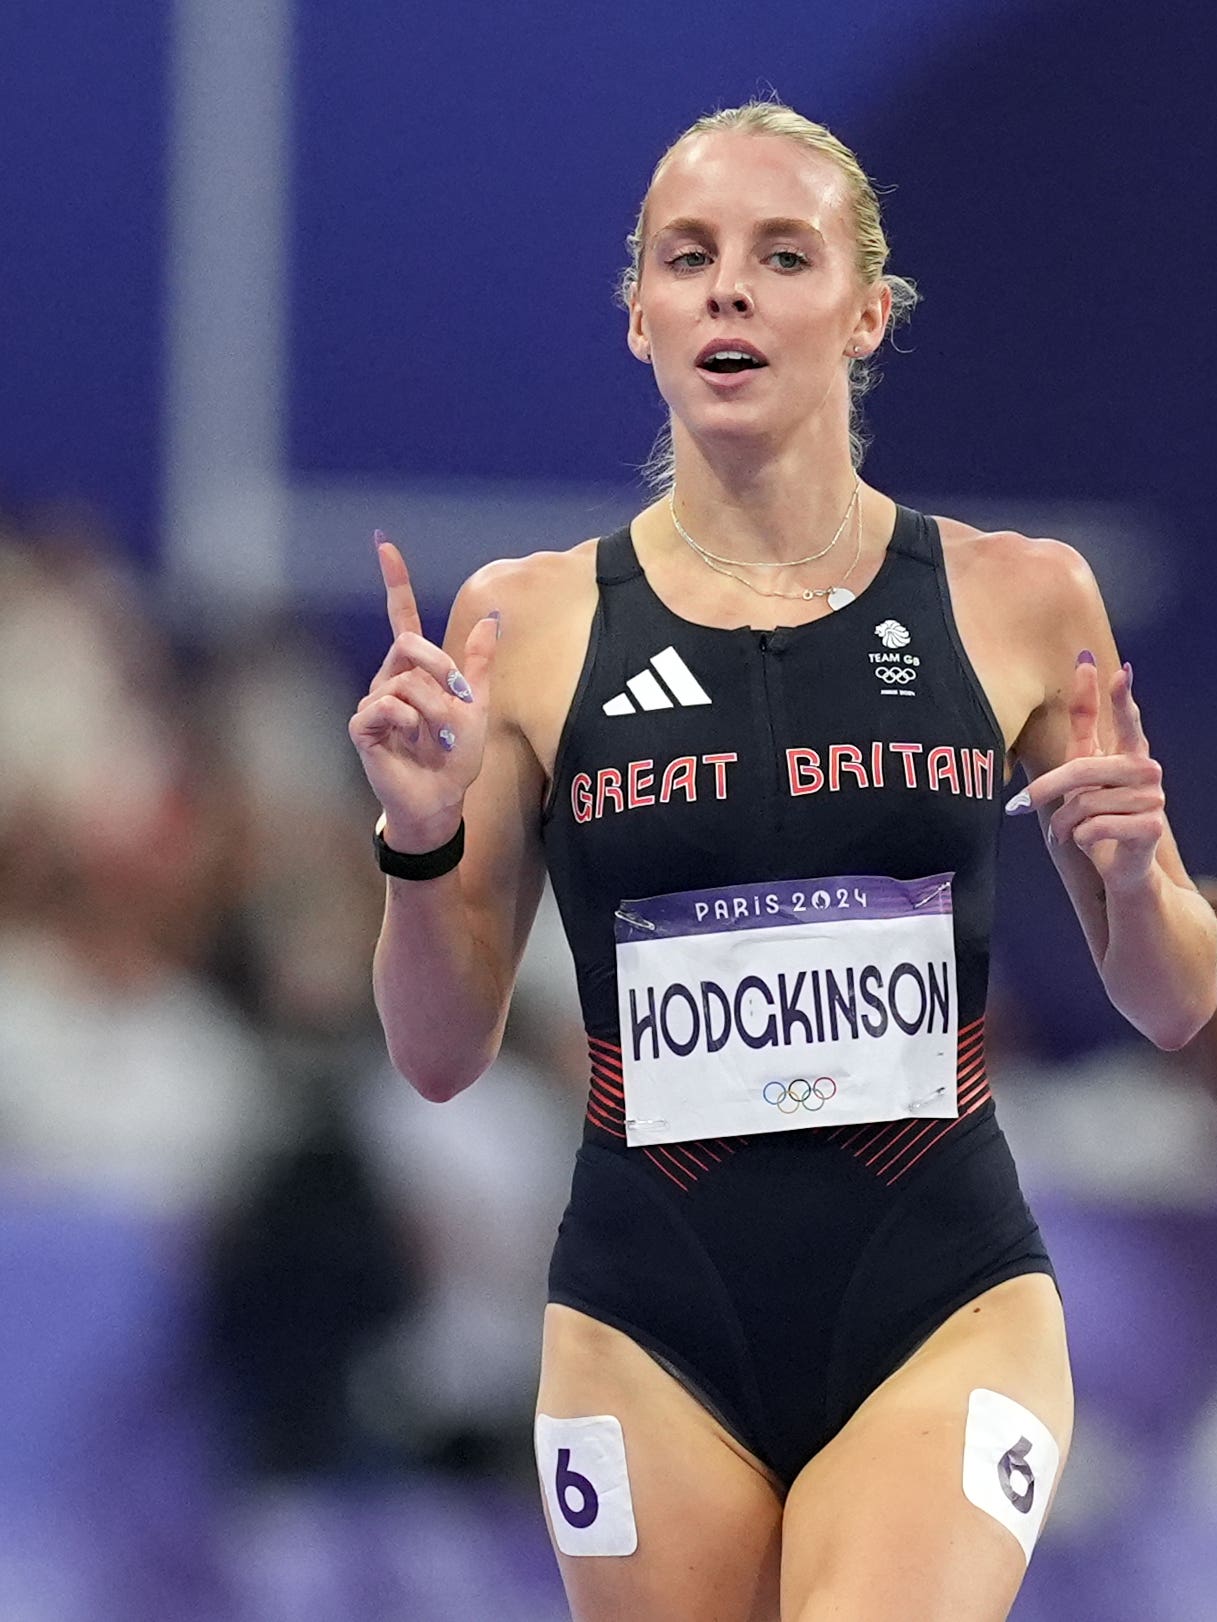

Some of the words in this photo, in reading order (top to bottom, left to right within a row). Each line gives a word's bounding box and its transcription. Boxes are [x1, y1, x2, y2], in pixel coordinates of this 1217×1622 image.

[868, 652, 900, 663] TEAM
[903, 654, 920, 667] GB
[571, 753, 738, 824] GREAT
[785, 742, 994, 800] BRITAIN
[694, 894, 780, 922] PARIS
[791, 888, 868, 912] 2024
[628, 961, 950, 1062] HODGKINSON
[555, 1447, 599, 1529] 6
[997, 1435, 1035, 1514] 6
